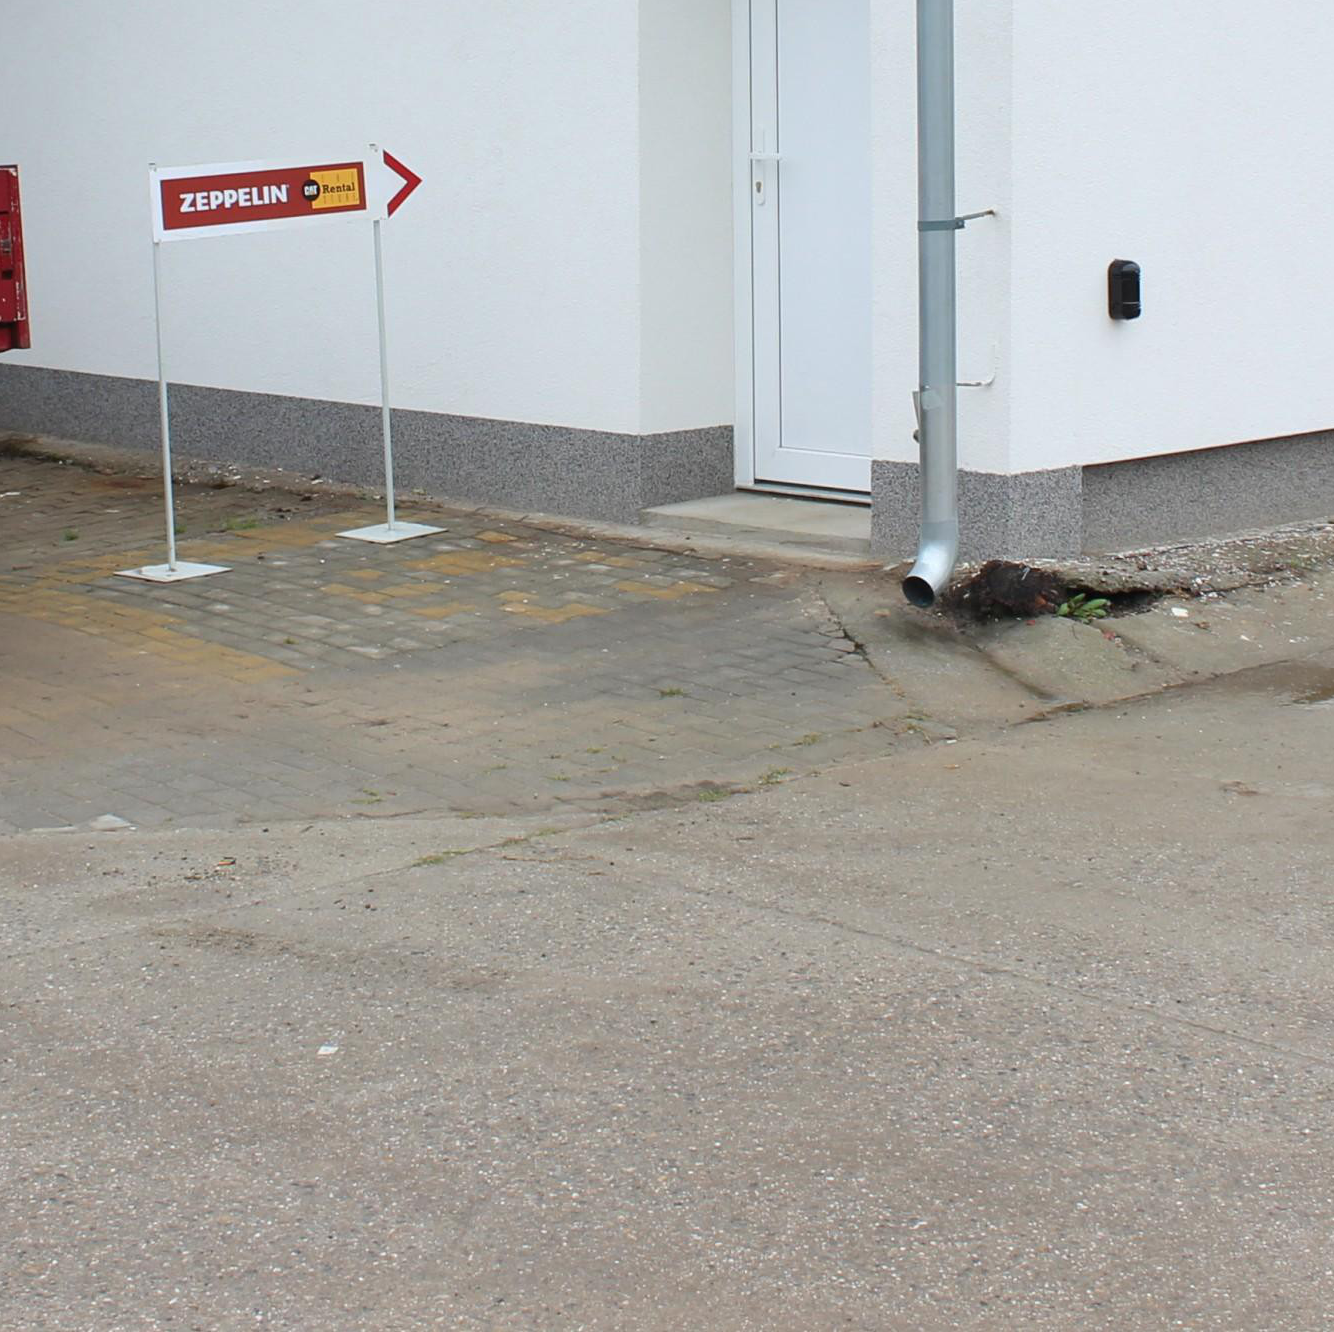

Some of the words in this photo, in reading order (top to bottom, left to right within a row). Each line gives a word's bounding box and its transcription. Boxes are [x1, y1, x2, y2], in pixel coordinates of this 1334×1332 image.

[303, 185, 318, 196] CAT
[322, 182, 355, 194] Rental
[179, 184, 289, 213] ZEPPELIN
